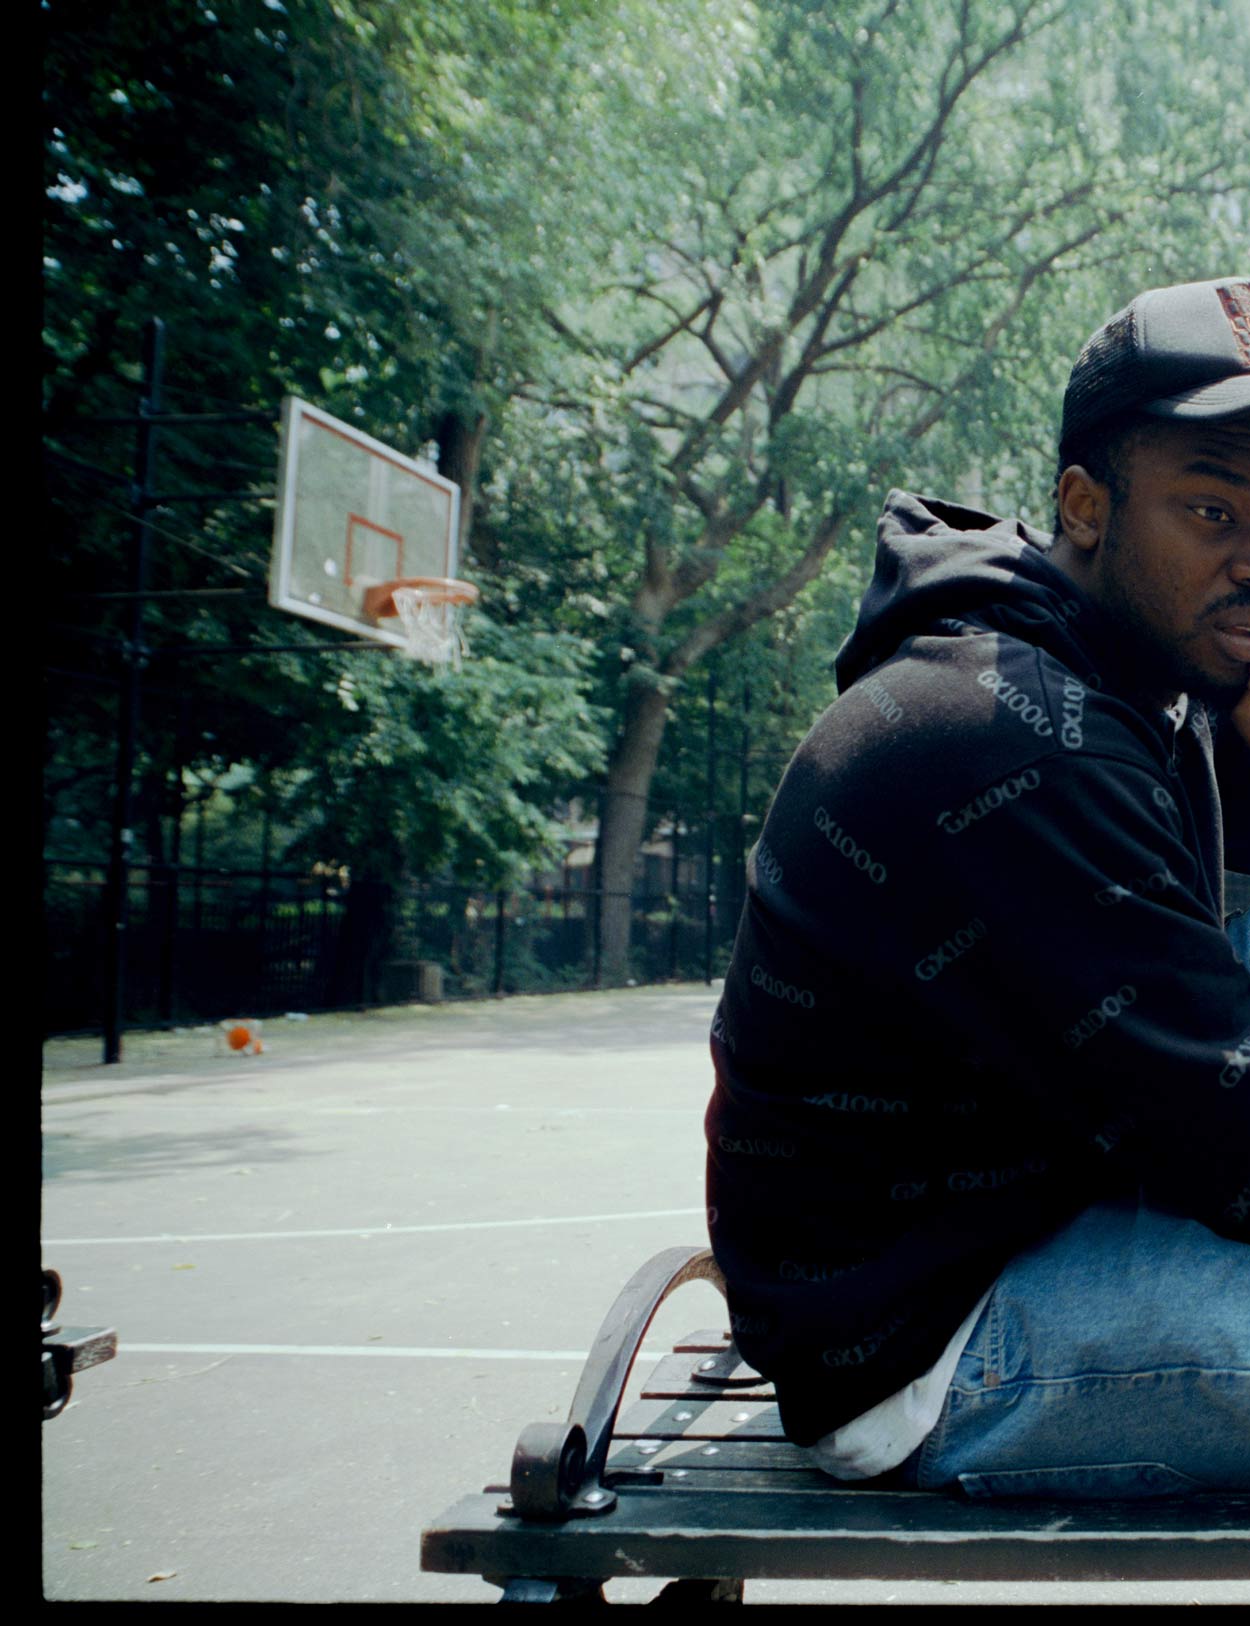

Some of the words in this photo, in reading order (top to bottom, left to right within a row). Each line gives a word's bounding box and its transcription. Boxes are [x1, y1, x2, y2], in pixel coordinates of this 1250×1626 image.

[977, 670, 1053, 737] GX1000
[936, 768, 1040, 834] GX1000
[812, 805, 887, 884] GX1000
